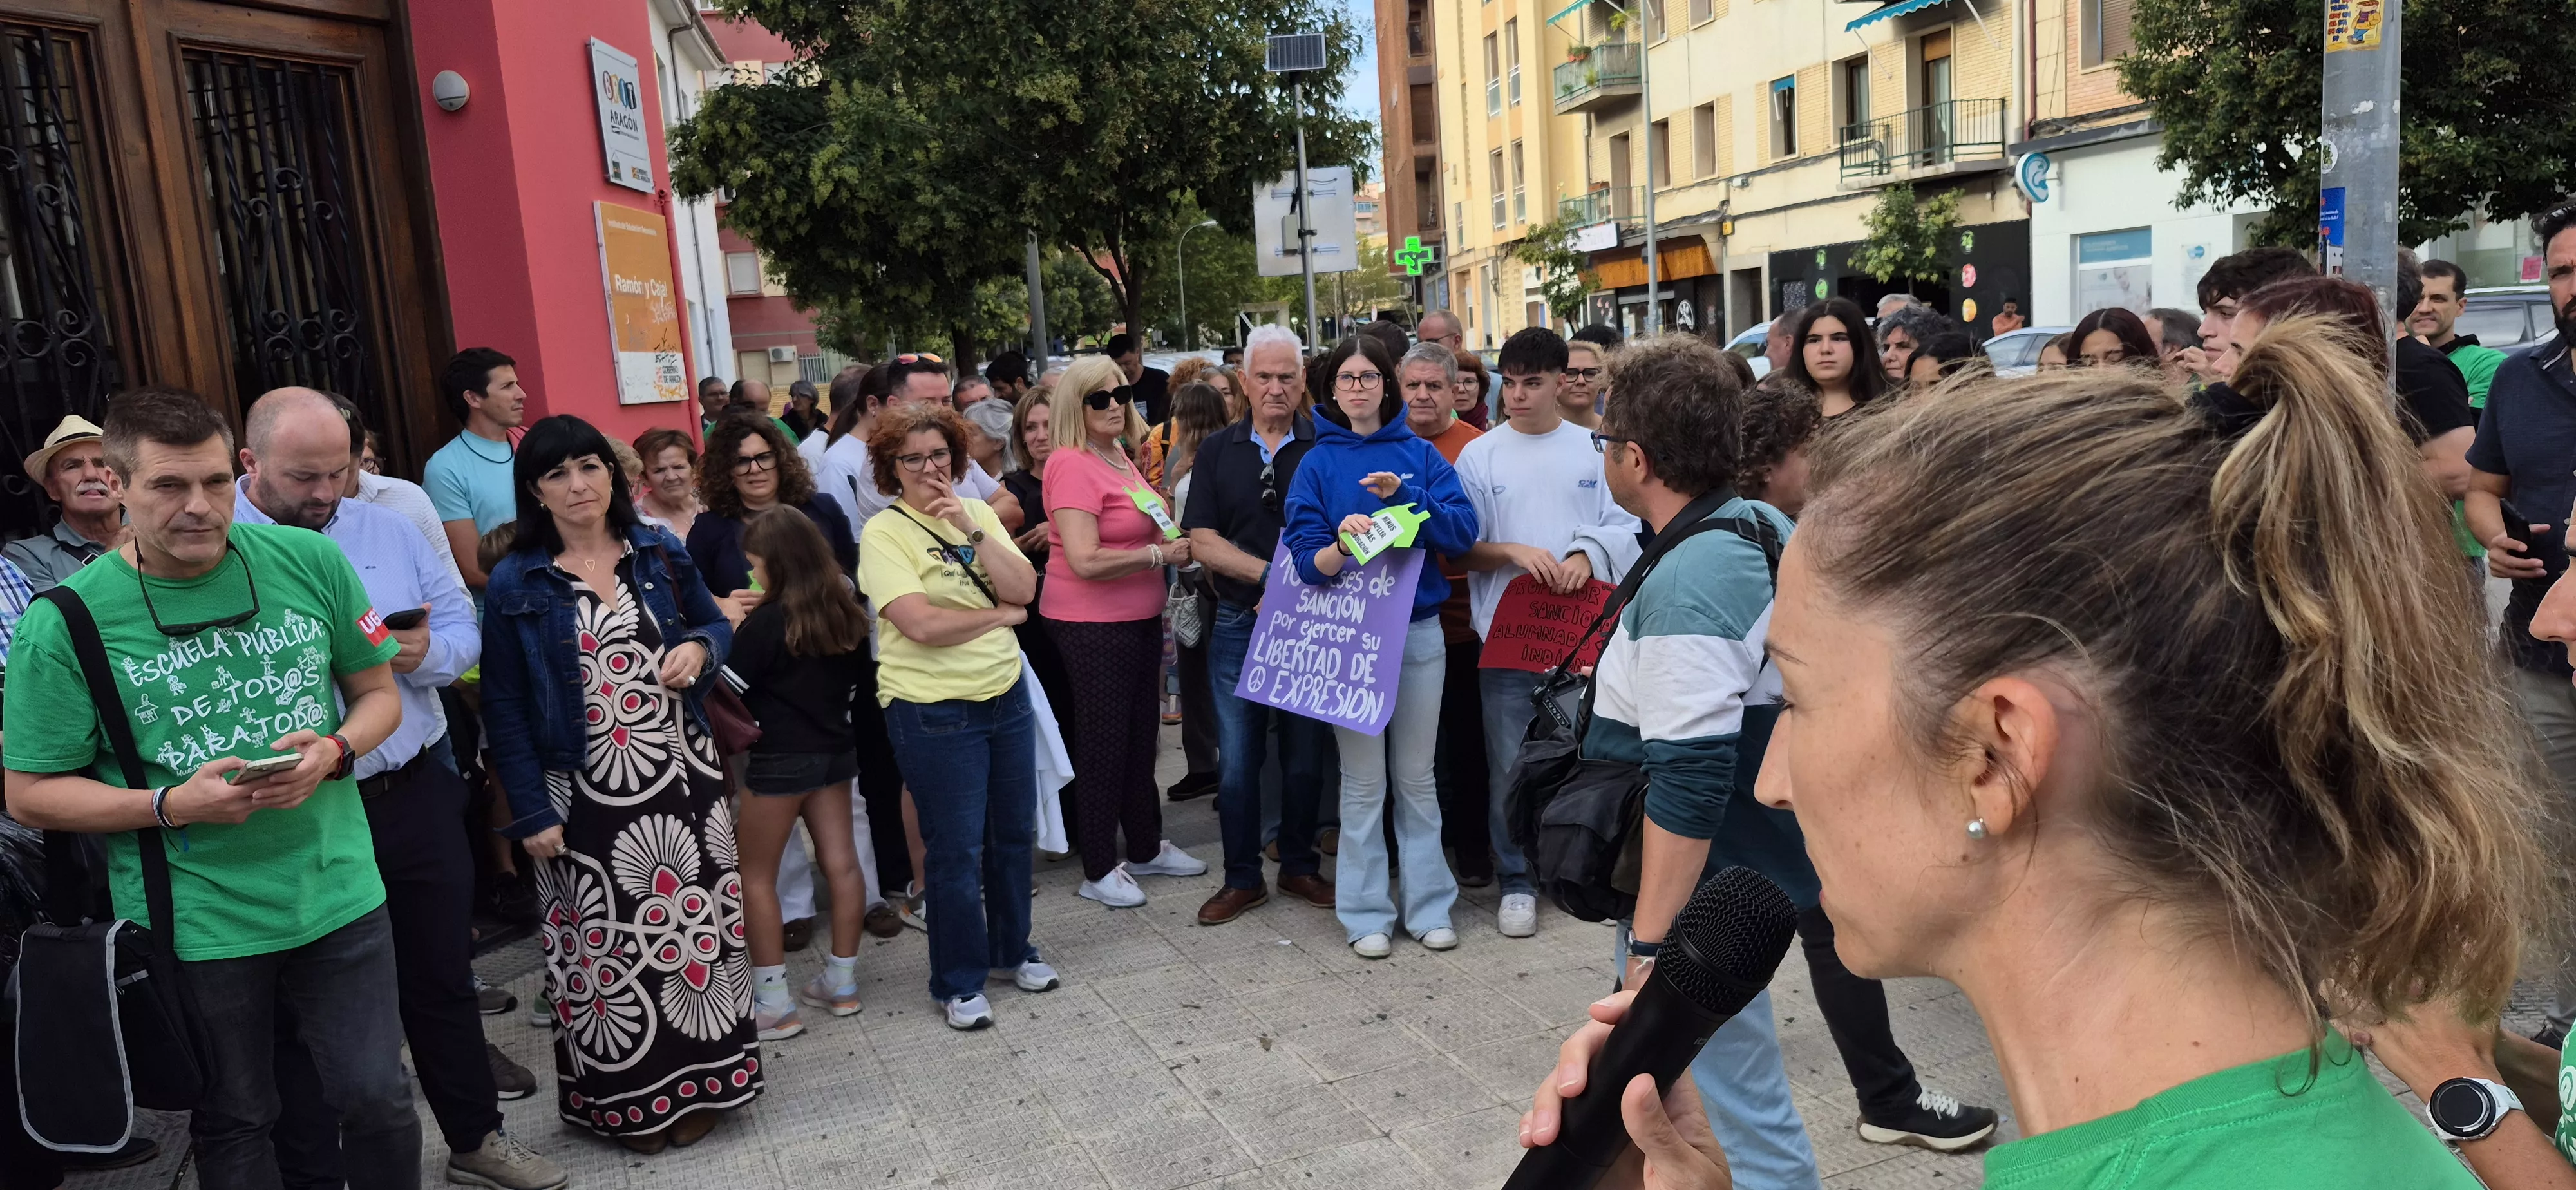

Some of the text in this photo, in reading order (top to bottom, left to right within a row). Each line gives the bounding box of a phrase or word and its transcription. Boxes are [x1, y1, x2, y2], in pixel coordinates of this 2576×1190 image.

[609, 109, 639, 133] ARAGÓN
[614, 273, 668, 299] Ramón y Cajal
[1381, 515, 1397, 532] MENOS
[1351, 533, 1370, 555] DUCACIÓN
[1368, 564, 1396, 599] de
[359, 611, 382, 634] UG
[1296, 587, 1367, 624] SANCIÓN
[1267, 610, 1381, 652] por ejercer su
[128, 631, 234, 686] ESCUELA
[1253, 632, 1378, 684] LIBERTAD DE
[170, 665, 320, 726] DE TOD@S
[1267, 670, 1385, 726] EXPRESIÓN
[167, 724, 252, 771] PARA
